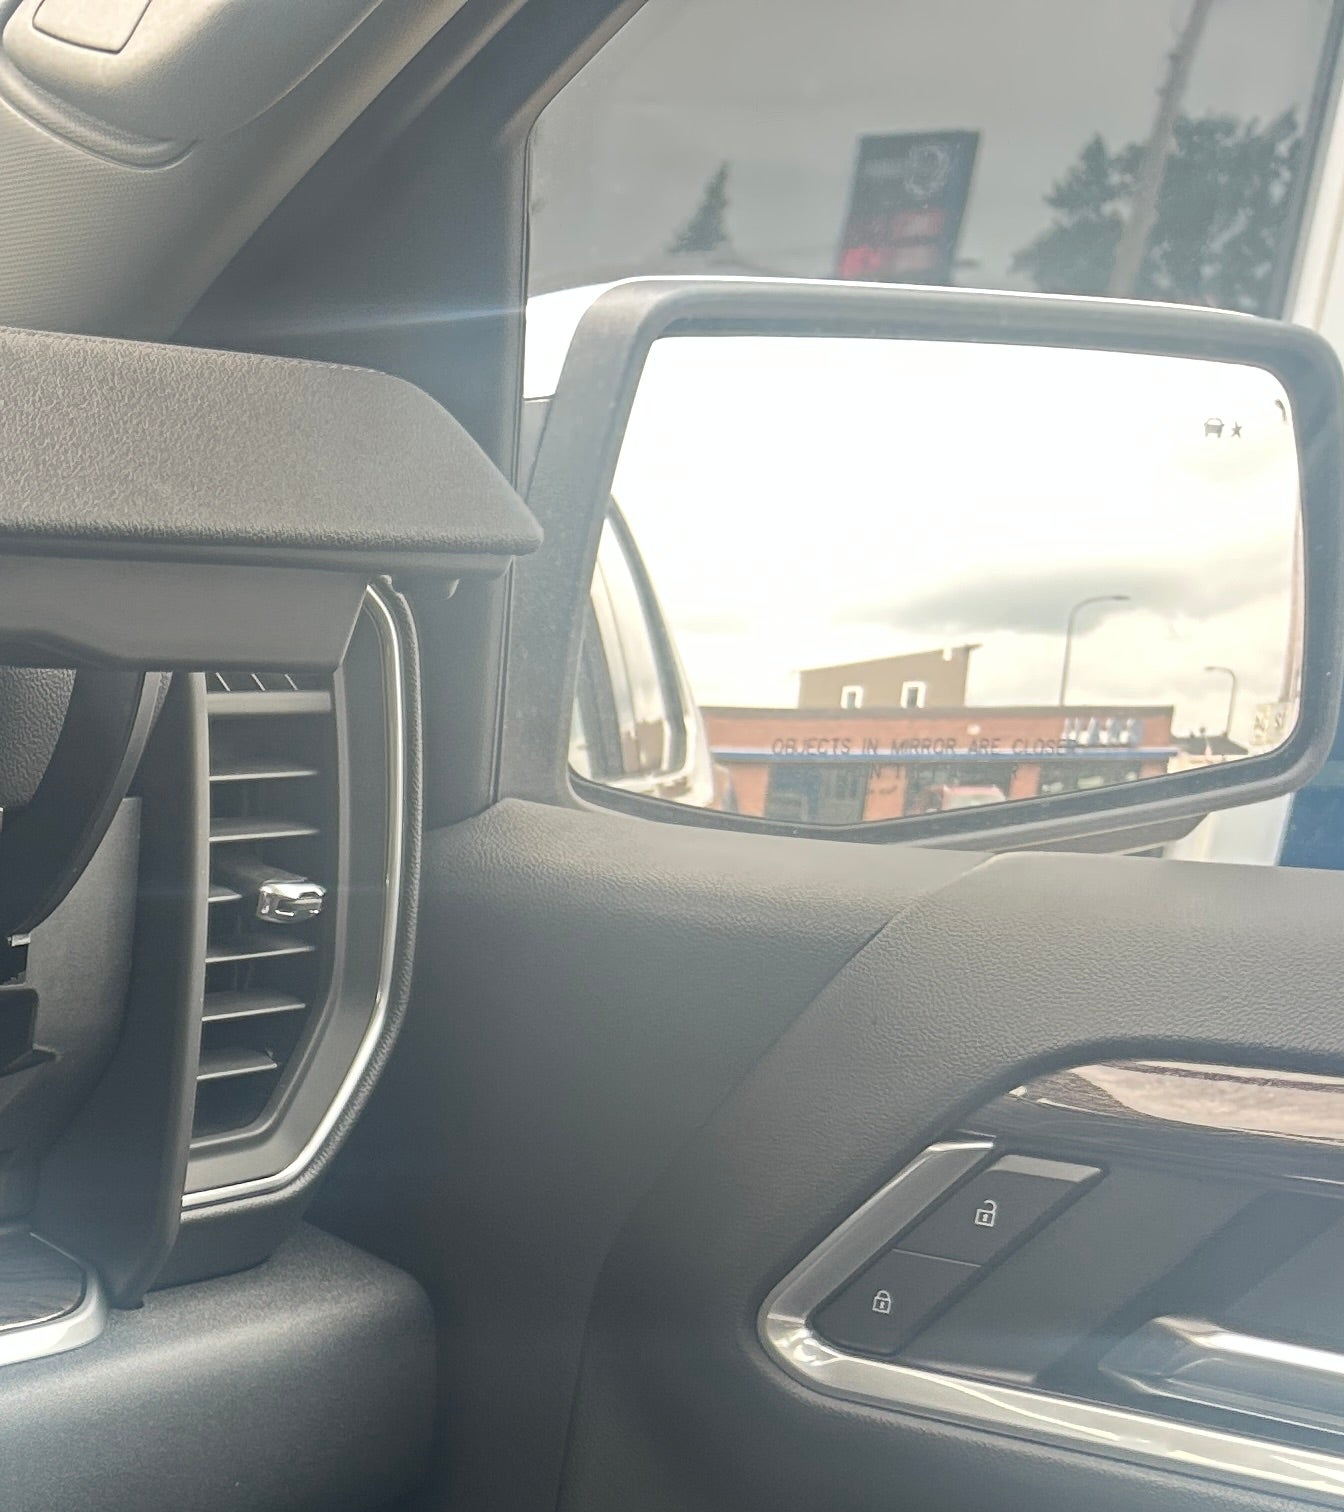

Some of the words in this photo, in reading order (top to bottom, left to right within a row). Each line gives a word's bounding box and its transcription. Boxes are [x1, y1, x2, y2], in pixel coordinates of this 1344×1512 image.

[772, 737, 852, 756] OBJECTS
[862, 737, 879, 755] IN
[890, 738, 957, 755] MIRROR
[967, 738, 1001, 755] ARE
